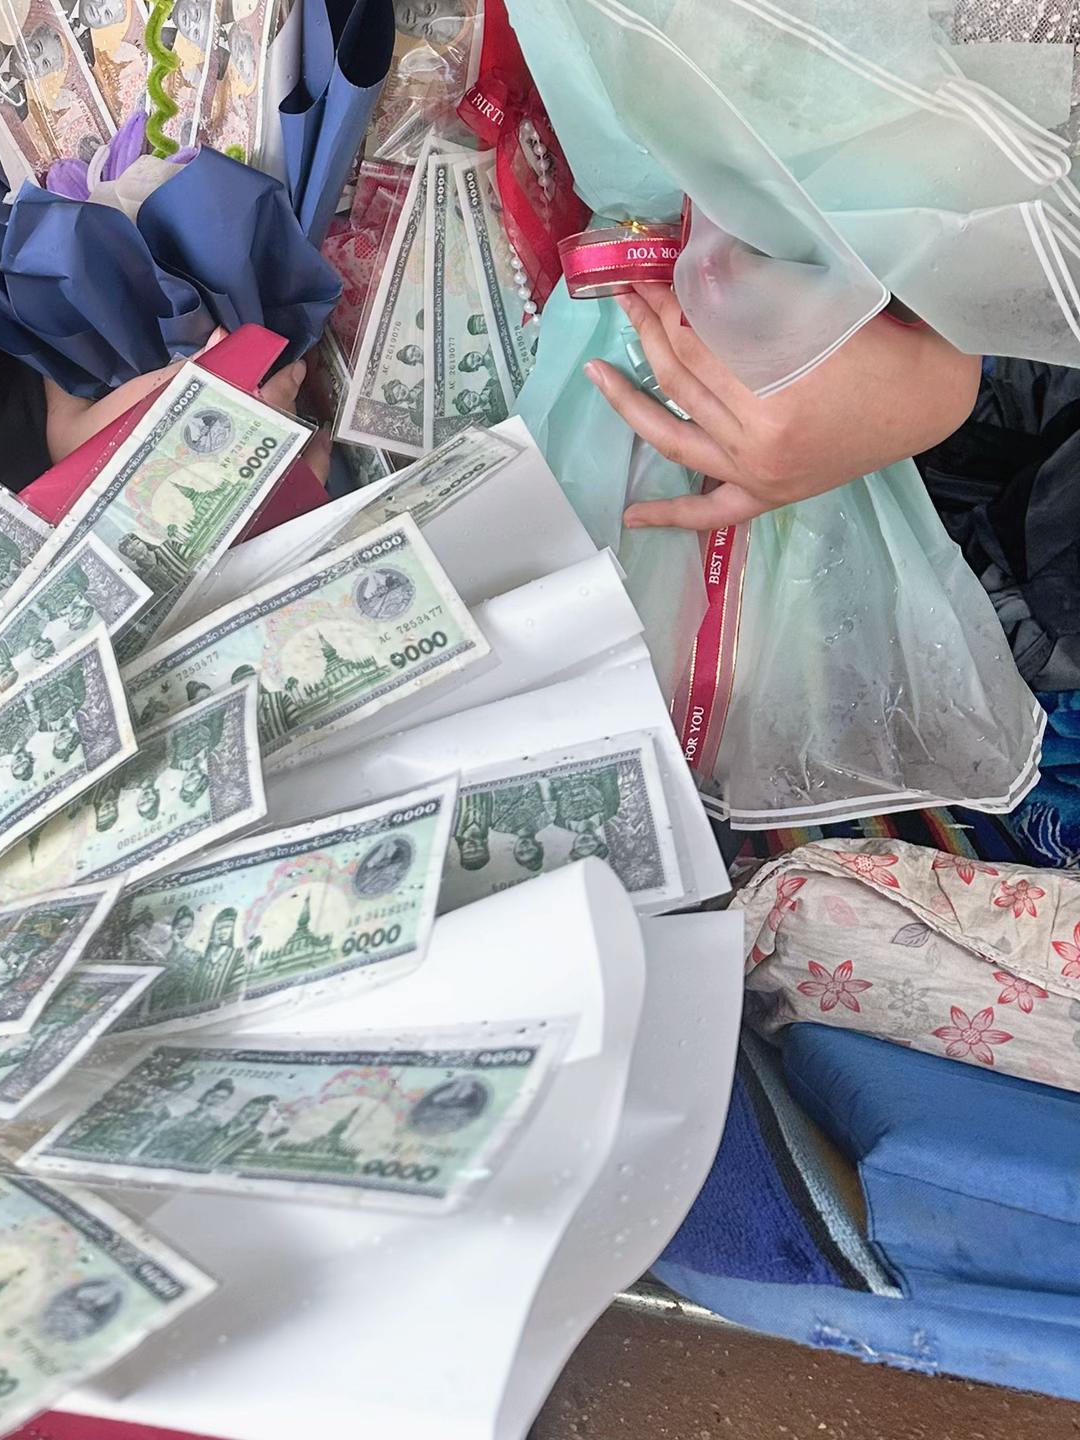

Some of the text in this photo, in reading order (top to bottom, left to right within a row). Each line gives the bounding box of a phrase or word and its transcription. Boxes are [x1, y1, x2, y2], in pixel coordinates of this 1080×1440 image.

[626, 246, 656, 261] YOU
[447, 336, 456, 389] AC 2619077
[707, 551, 724, 586] BEST
[378, 606, 444, 644] AC 7253477
[175, 651, 220, 682] 7253477
[683, 704, 705, 762] FOR YOU
